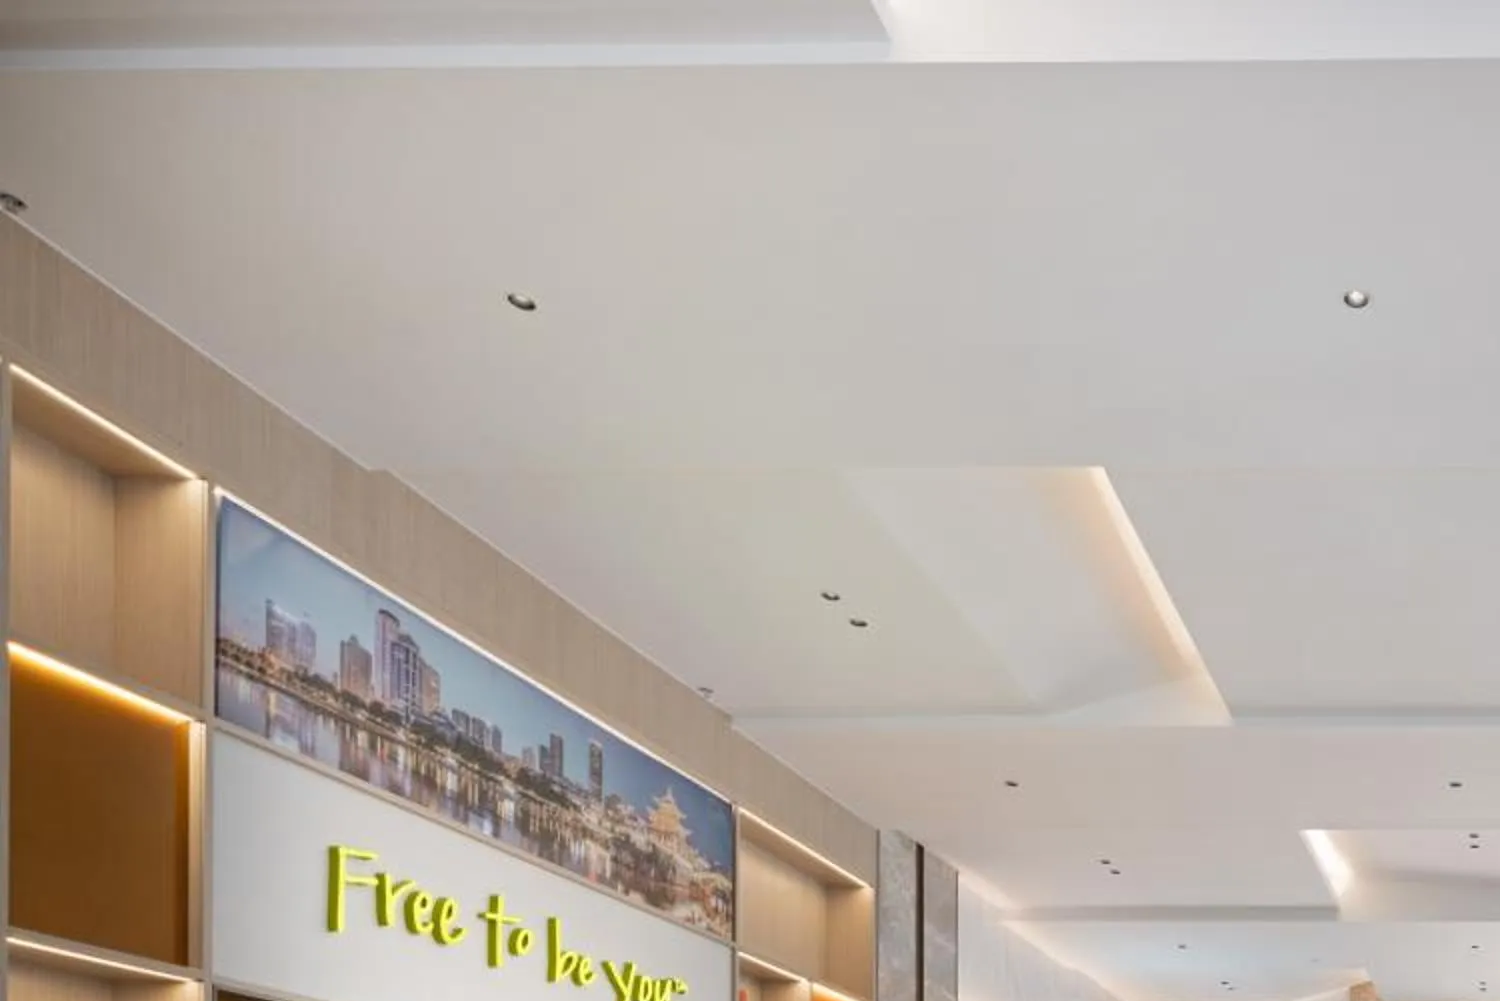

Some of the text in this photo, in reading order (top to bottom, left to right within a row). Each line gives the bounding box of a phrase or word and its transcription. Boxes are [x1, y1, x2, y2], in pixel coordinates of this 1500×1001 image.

[327, 845, 469, 946] Free
[478, 894, 536, 968] to
[546, 917, 597, 986] be
